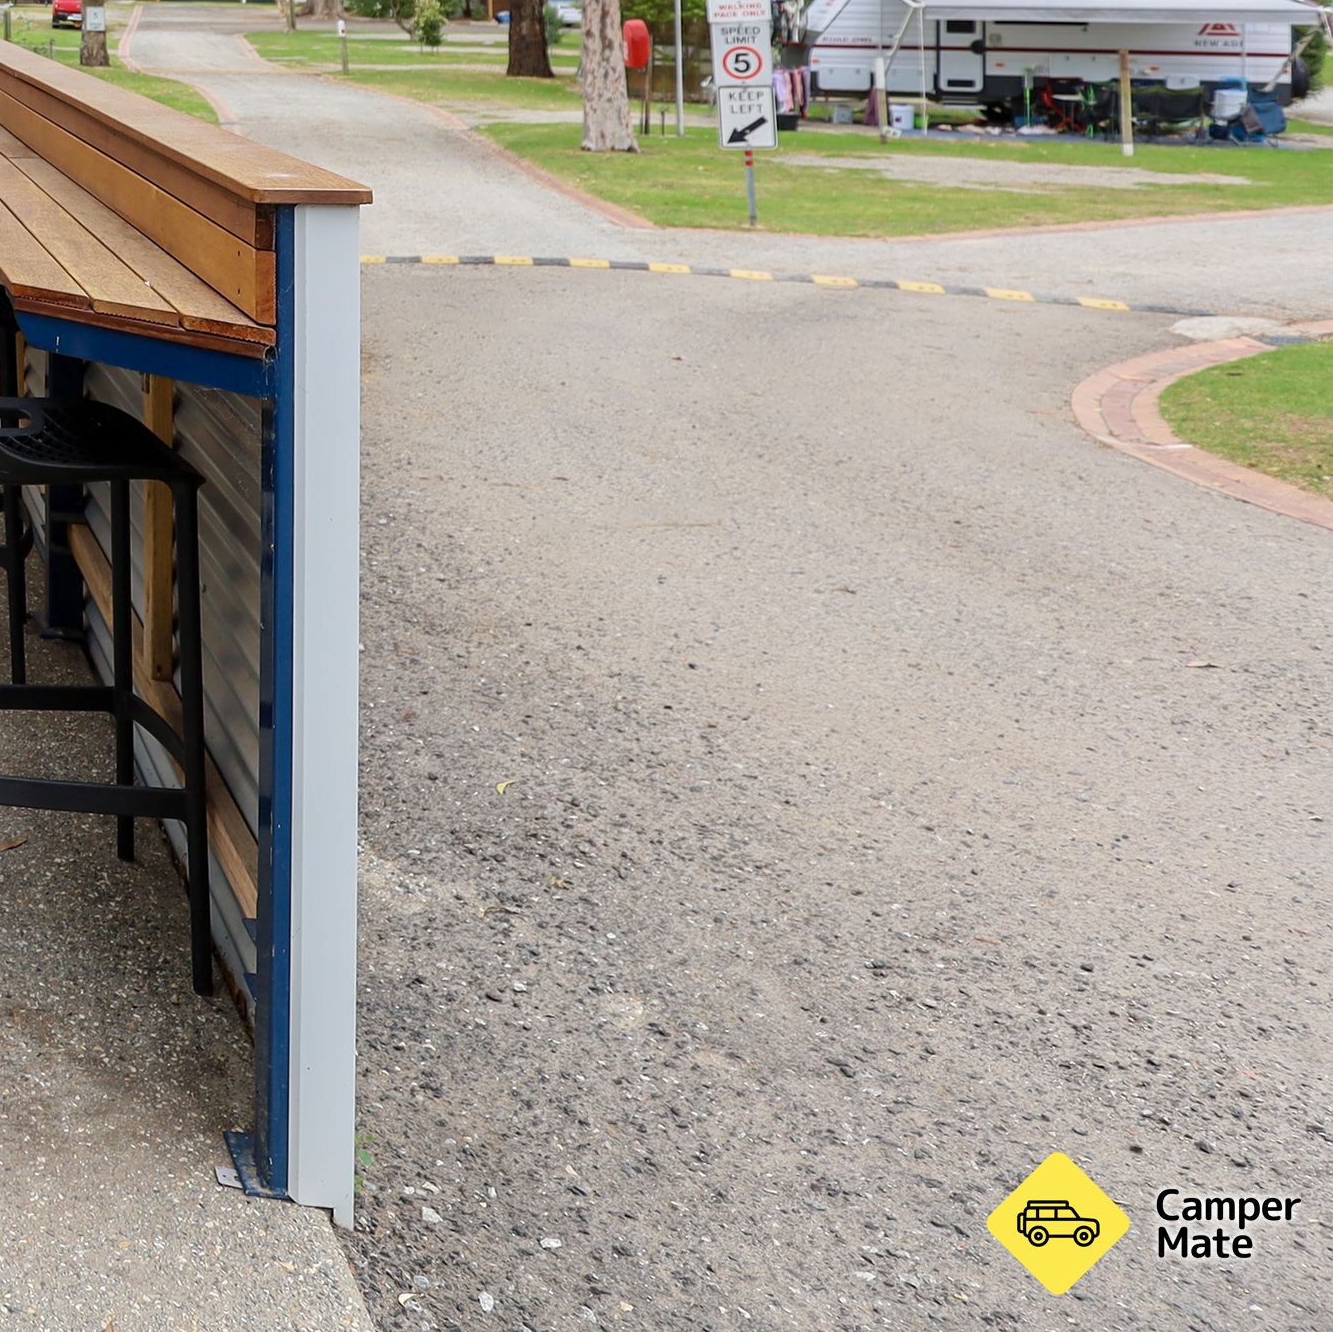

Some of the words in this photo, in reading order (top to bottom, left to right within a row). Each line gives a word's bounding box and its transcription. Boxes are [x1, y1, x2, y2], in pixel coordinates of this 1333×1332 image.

[721, 26, 761, 36] SPEED
[725, 36, 757, 45] LIMIT
[733, 52, 750, 74] 5
[729, 91, 764, 102] KEEP
[731, 104, 763, 115] LEFT
